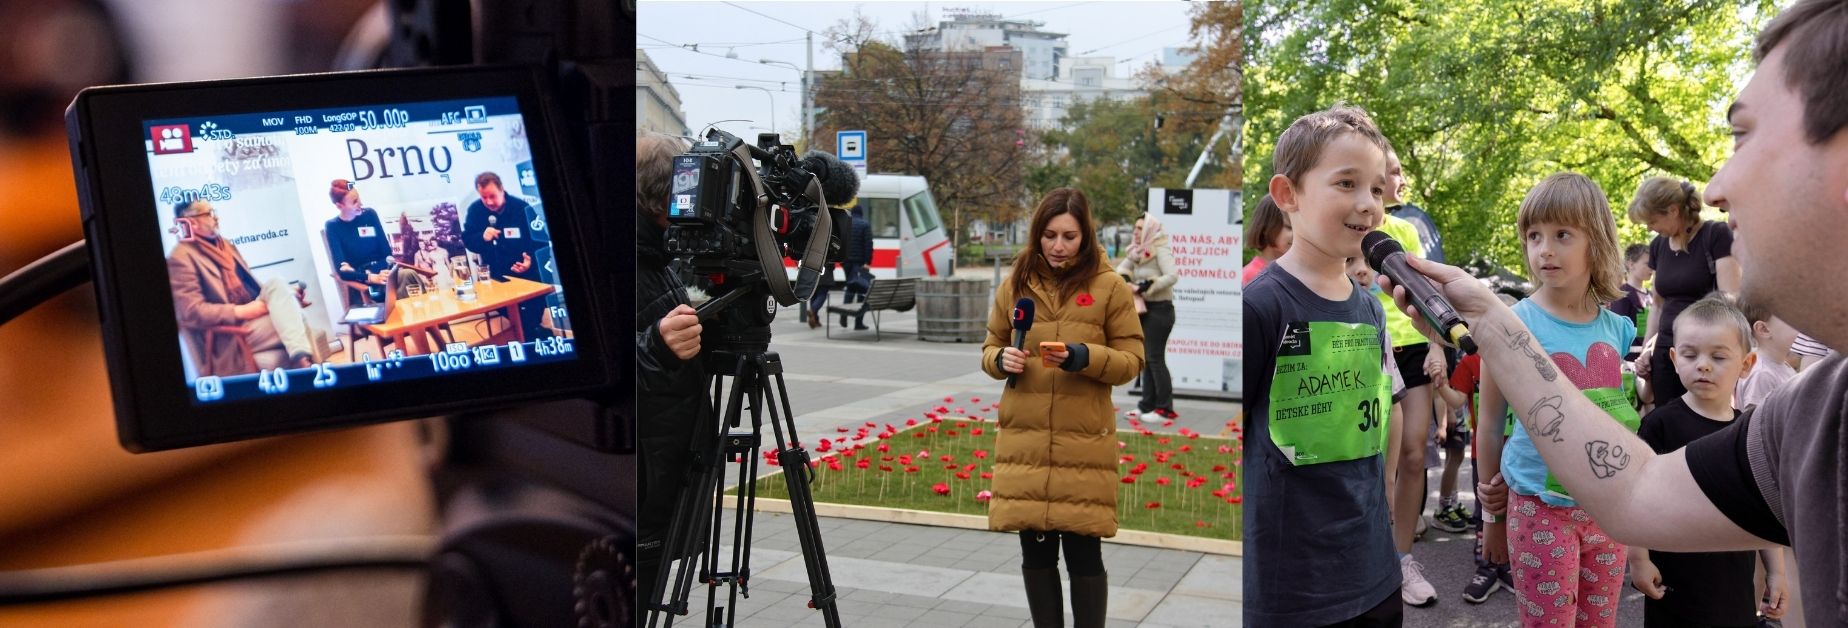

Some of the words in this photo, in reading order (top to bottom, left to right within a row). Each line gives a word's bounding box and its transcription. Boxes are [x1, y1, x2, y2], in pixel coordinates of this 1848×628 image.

[262, 117, 284, 127] MOV
[294, 115, 313, 125] FHD
[322, 111, 357, 123] LongGOP
[440, 110, 462, 126] AFC
[328, 122, 356, 133] 422/10
[346, 137, 453, 182] Brno
[160, 183, 232, 205] 48m43s
[1172, 235, 1187, 243] NA
[1189, 233, 1215, 245] NÁS,
[1217, 236, 1240, 245] ABY
[1172, 246, 1187, 255] NA
[1189, 246, 1229, 256] JEJICH
[1174, 256, 1203, 266] BĚHY
[1176, 267, 1237, 279] APOMNĚLO
[550, 305, 567, 319] Fn
[534, 335, 573, 357] 4h38m
[429, 350, 470, 372] 1000
[258, 367, 289, 394] 4.0
[311, 362, 337, 388] 25
[1297, 366, 1366, 396] ADÁMEK
[1357, 397, 1380, 433] 30
